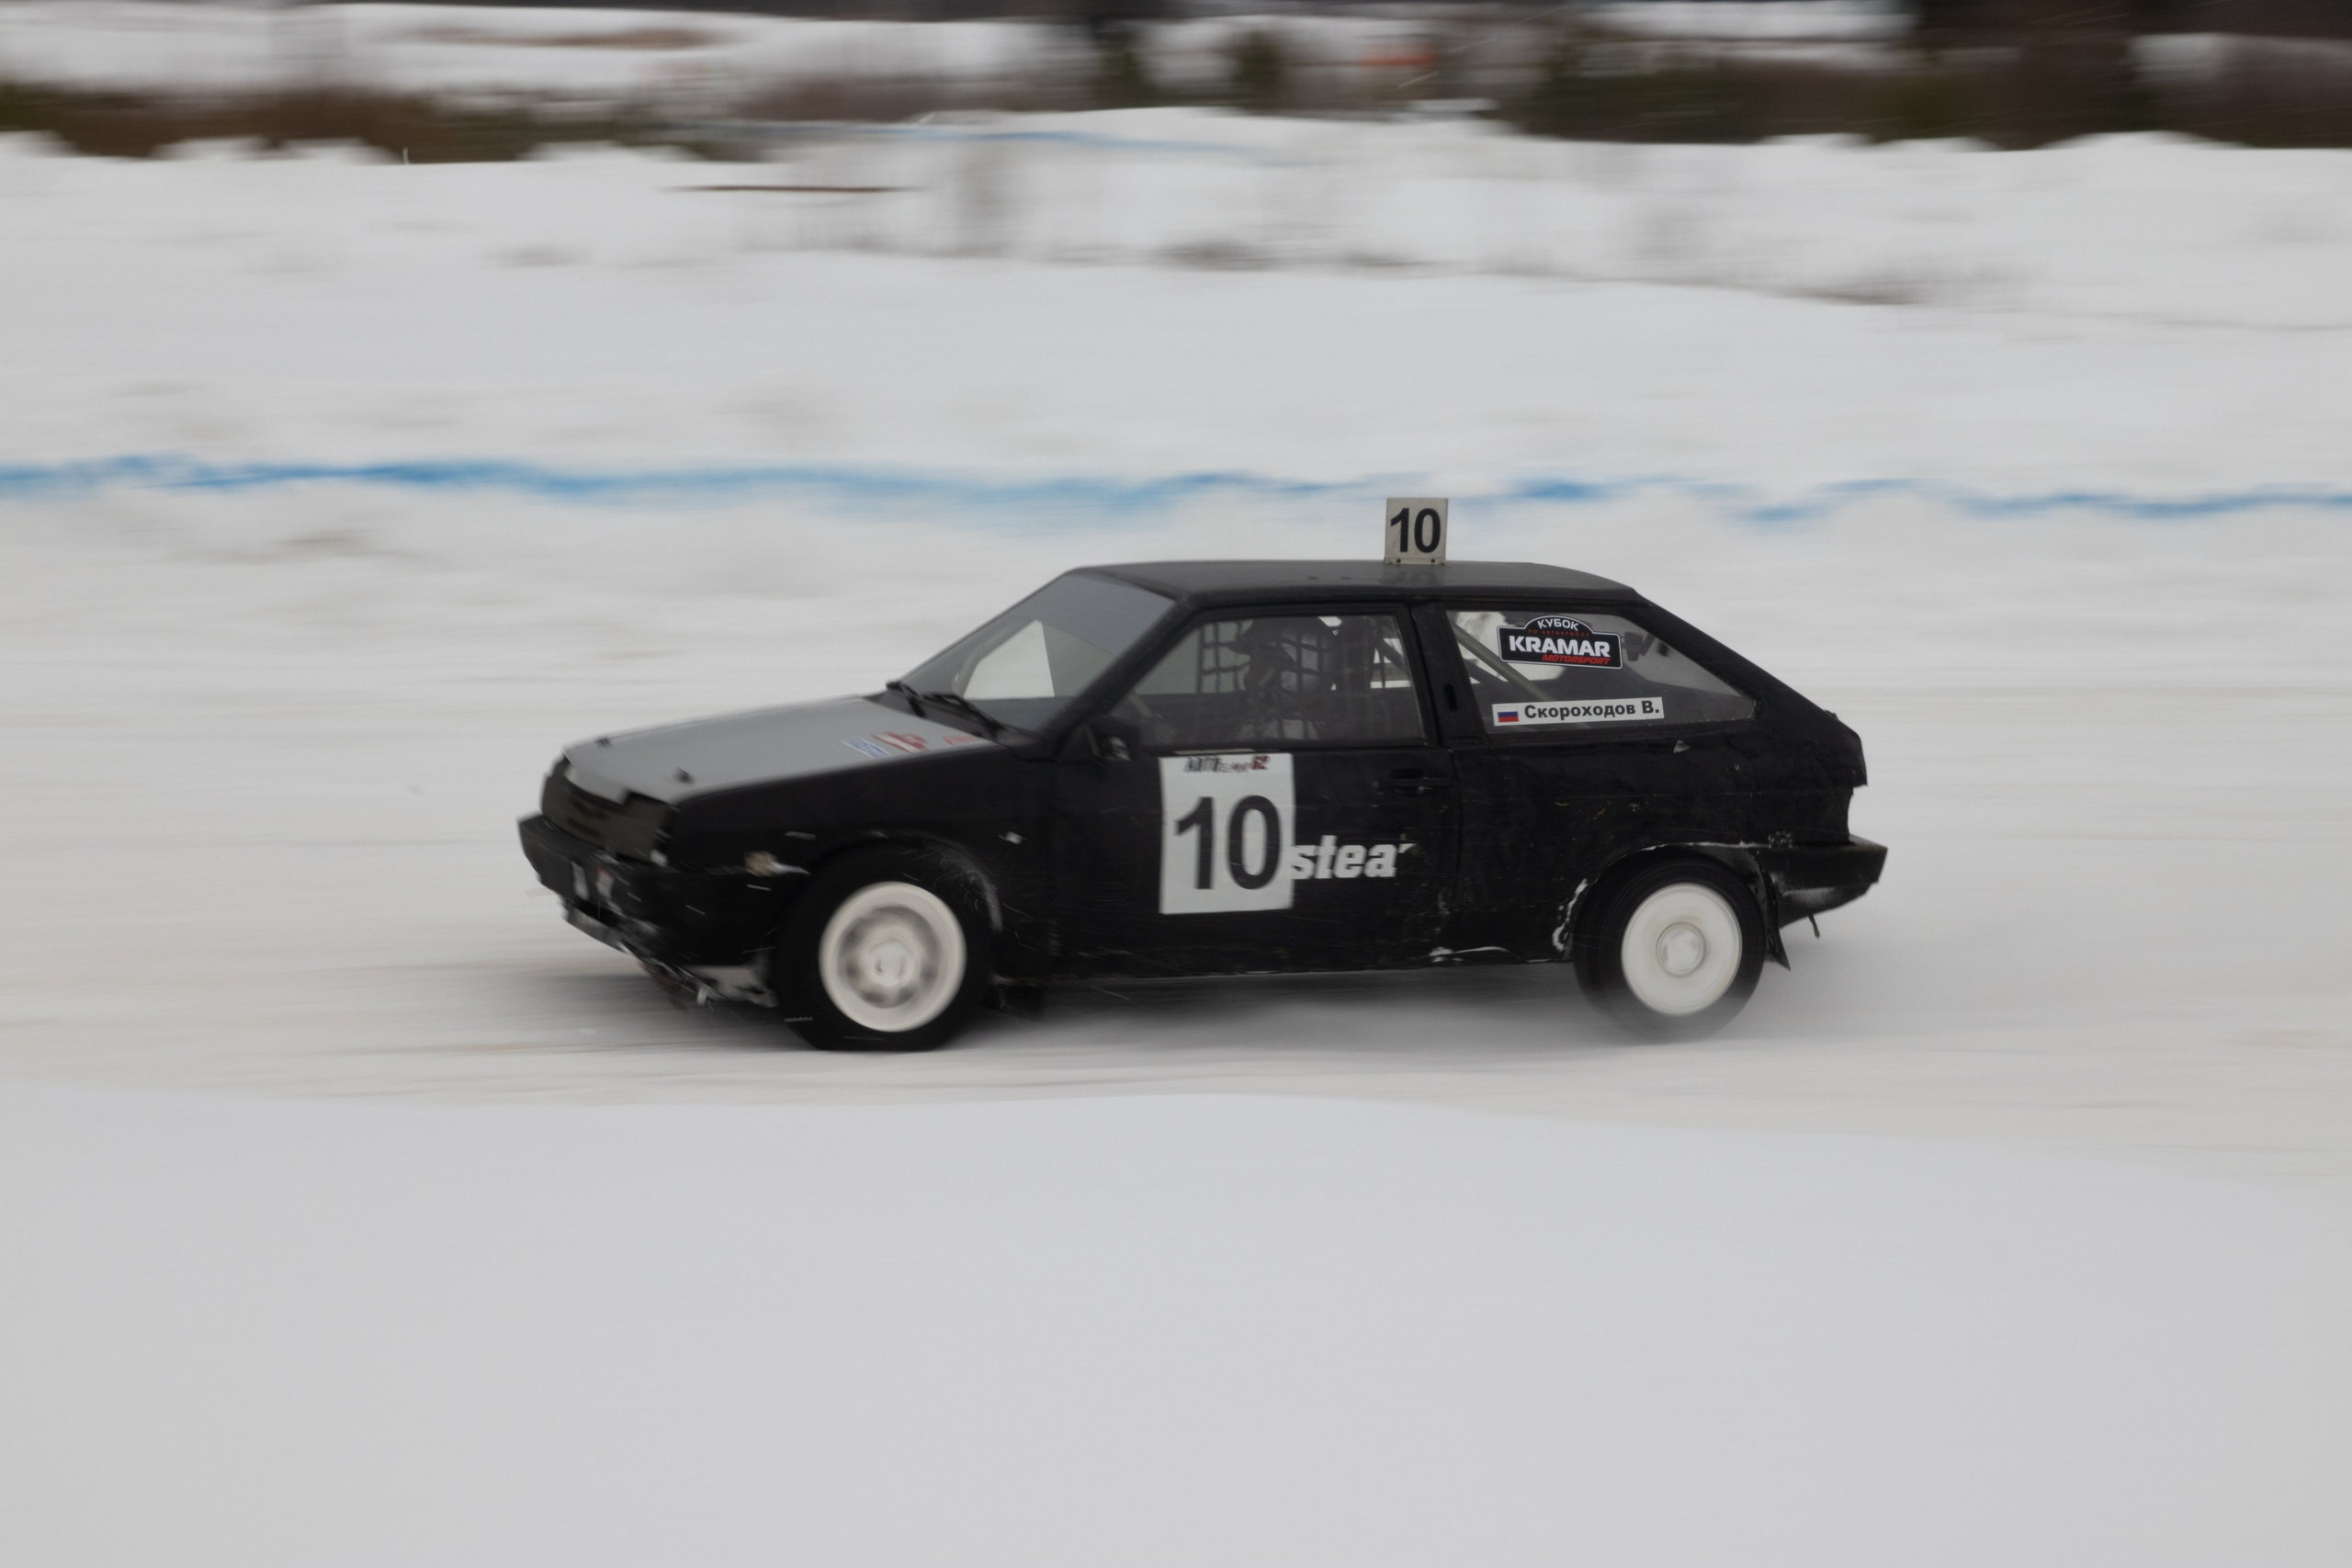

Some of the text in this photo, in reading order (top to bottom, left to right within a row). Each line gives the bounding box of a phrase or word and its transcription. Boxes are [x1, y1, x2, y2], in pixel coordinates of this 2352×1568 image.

[1390, 507, 1441, 553] 10
[1537, 618, 1579, 631] КУБОК
[1509, 635, 1611, 657] KRAMAR
[1542, 654, 1611, 666] MOTORSPORT
[1524, 700, 1659, 720] Скороходов В.
[1173, 795, 1281, 890] 10
